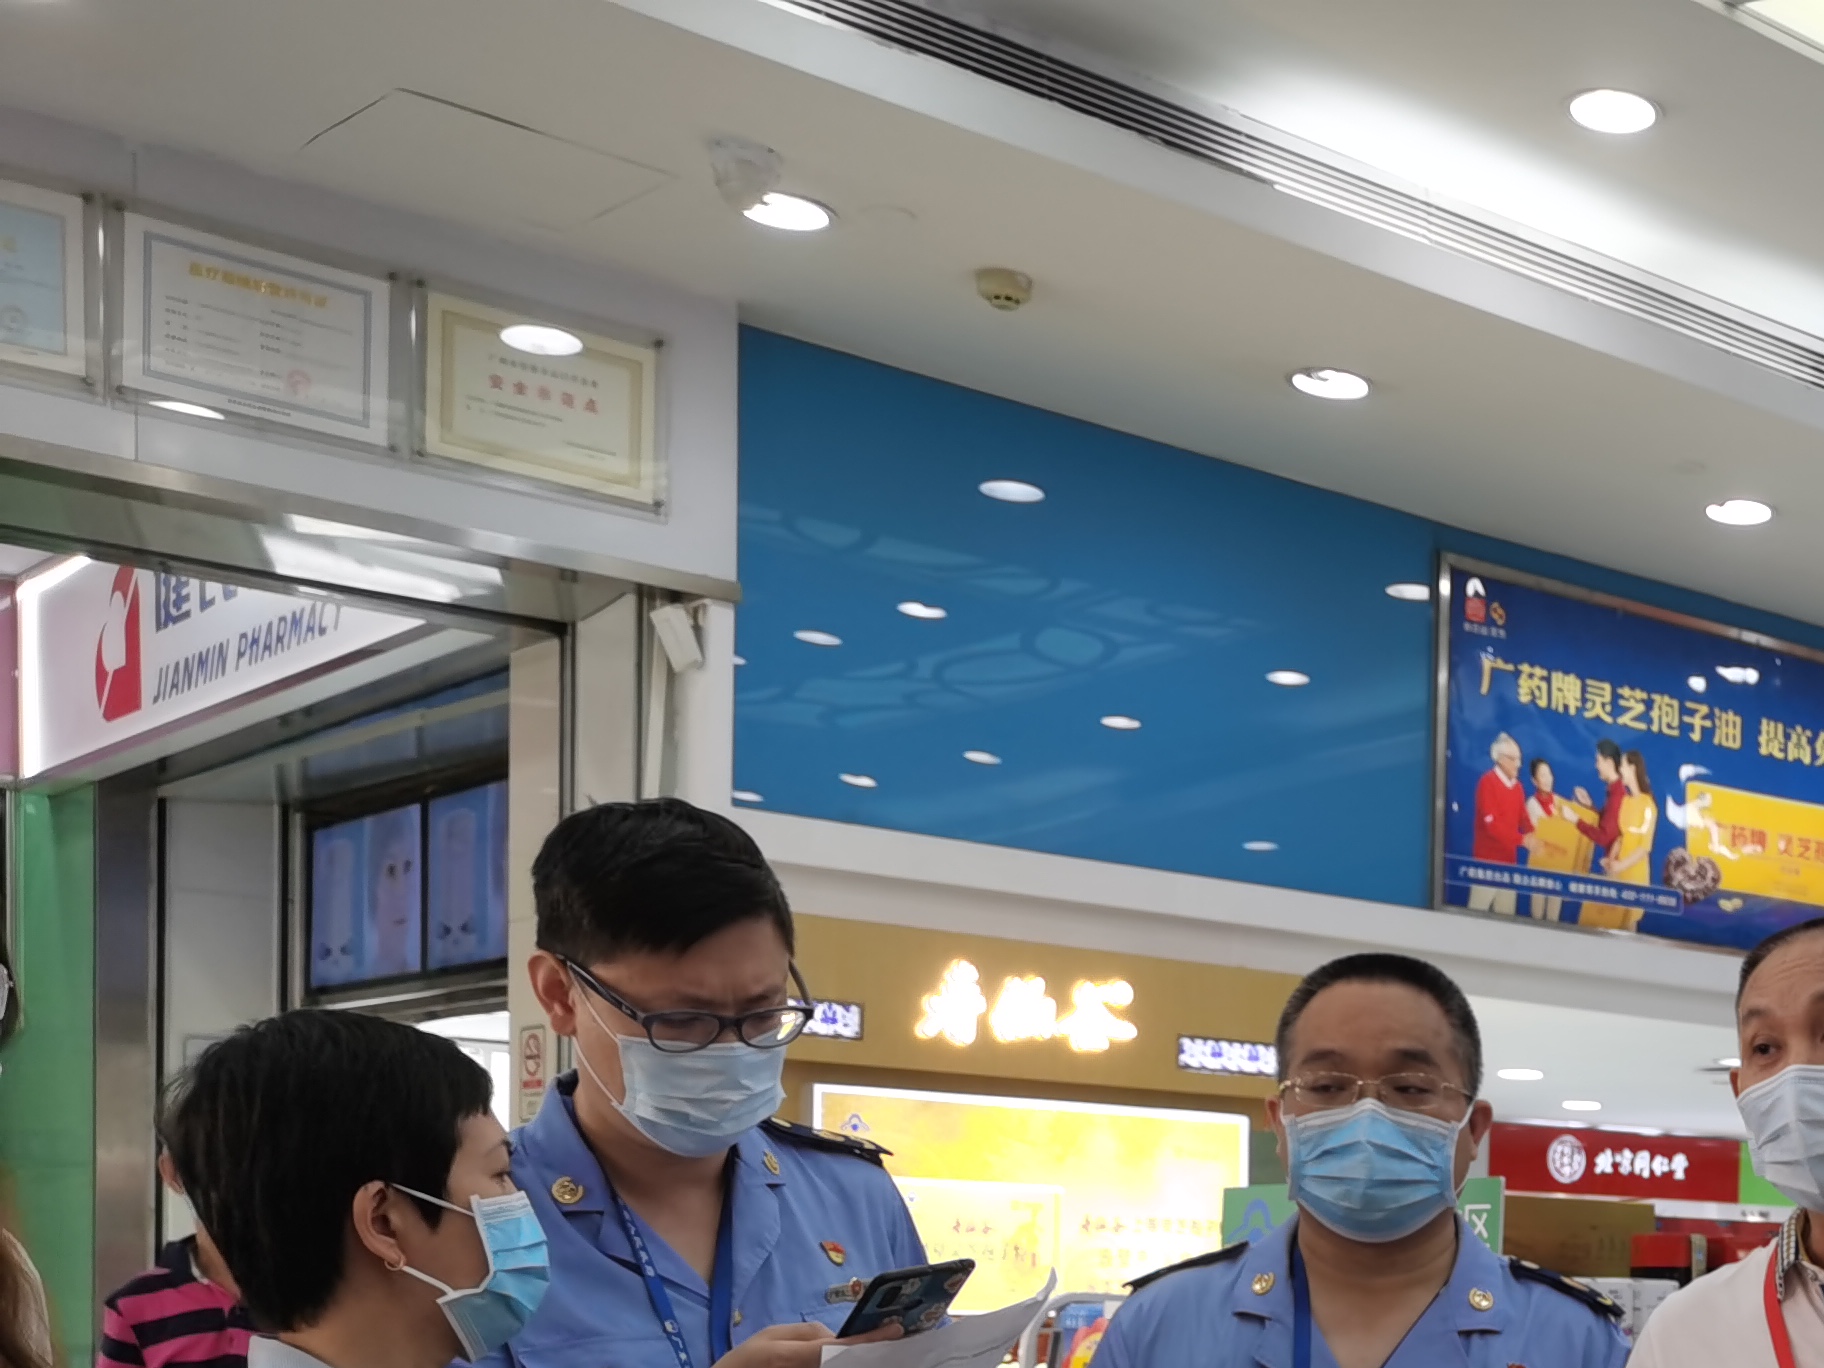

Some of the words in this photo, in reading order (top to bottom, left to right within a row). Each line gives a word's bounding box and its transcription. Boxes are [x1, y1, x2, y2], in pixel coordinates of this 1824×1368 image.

[152, 638, 230, 706] JIANMIN
[1480, 656, 1744, 750] 广药牌灵芝孢子油
